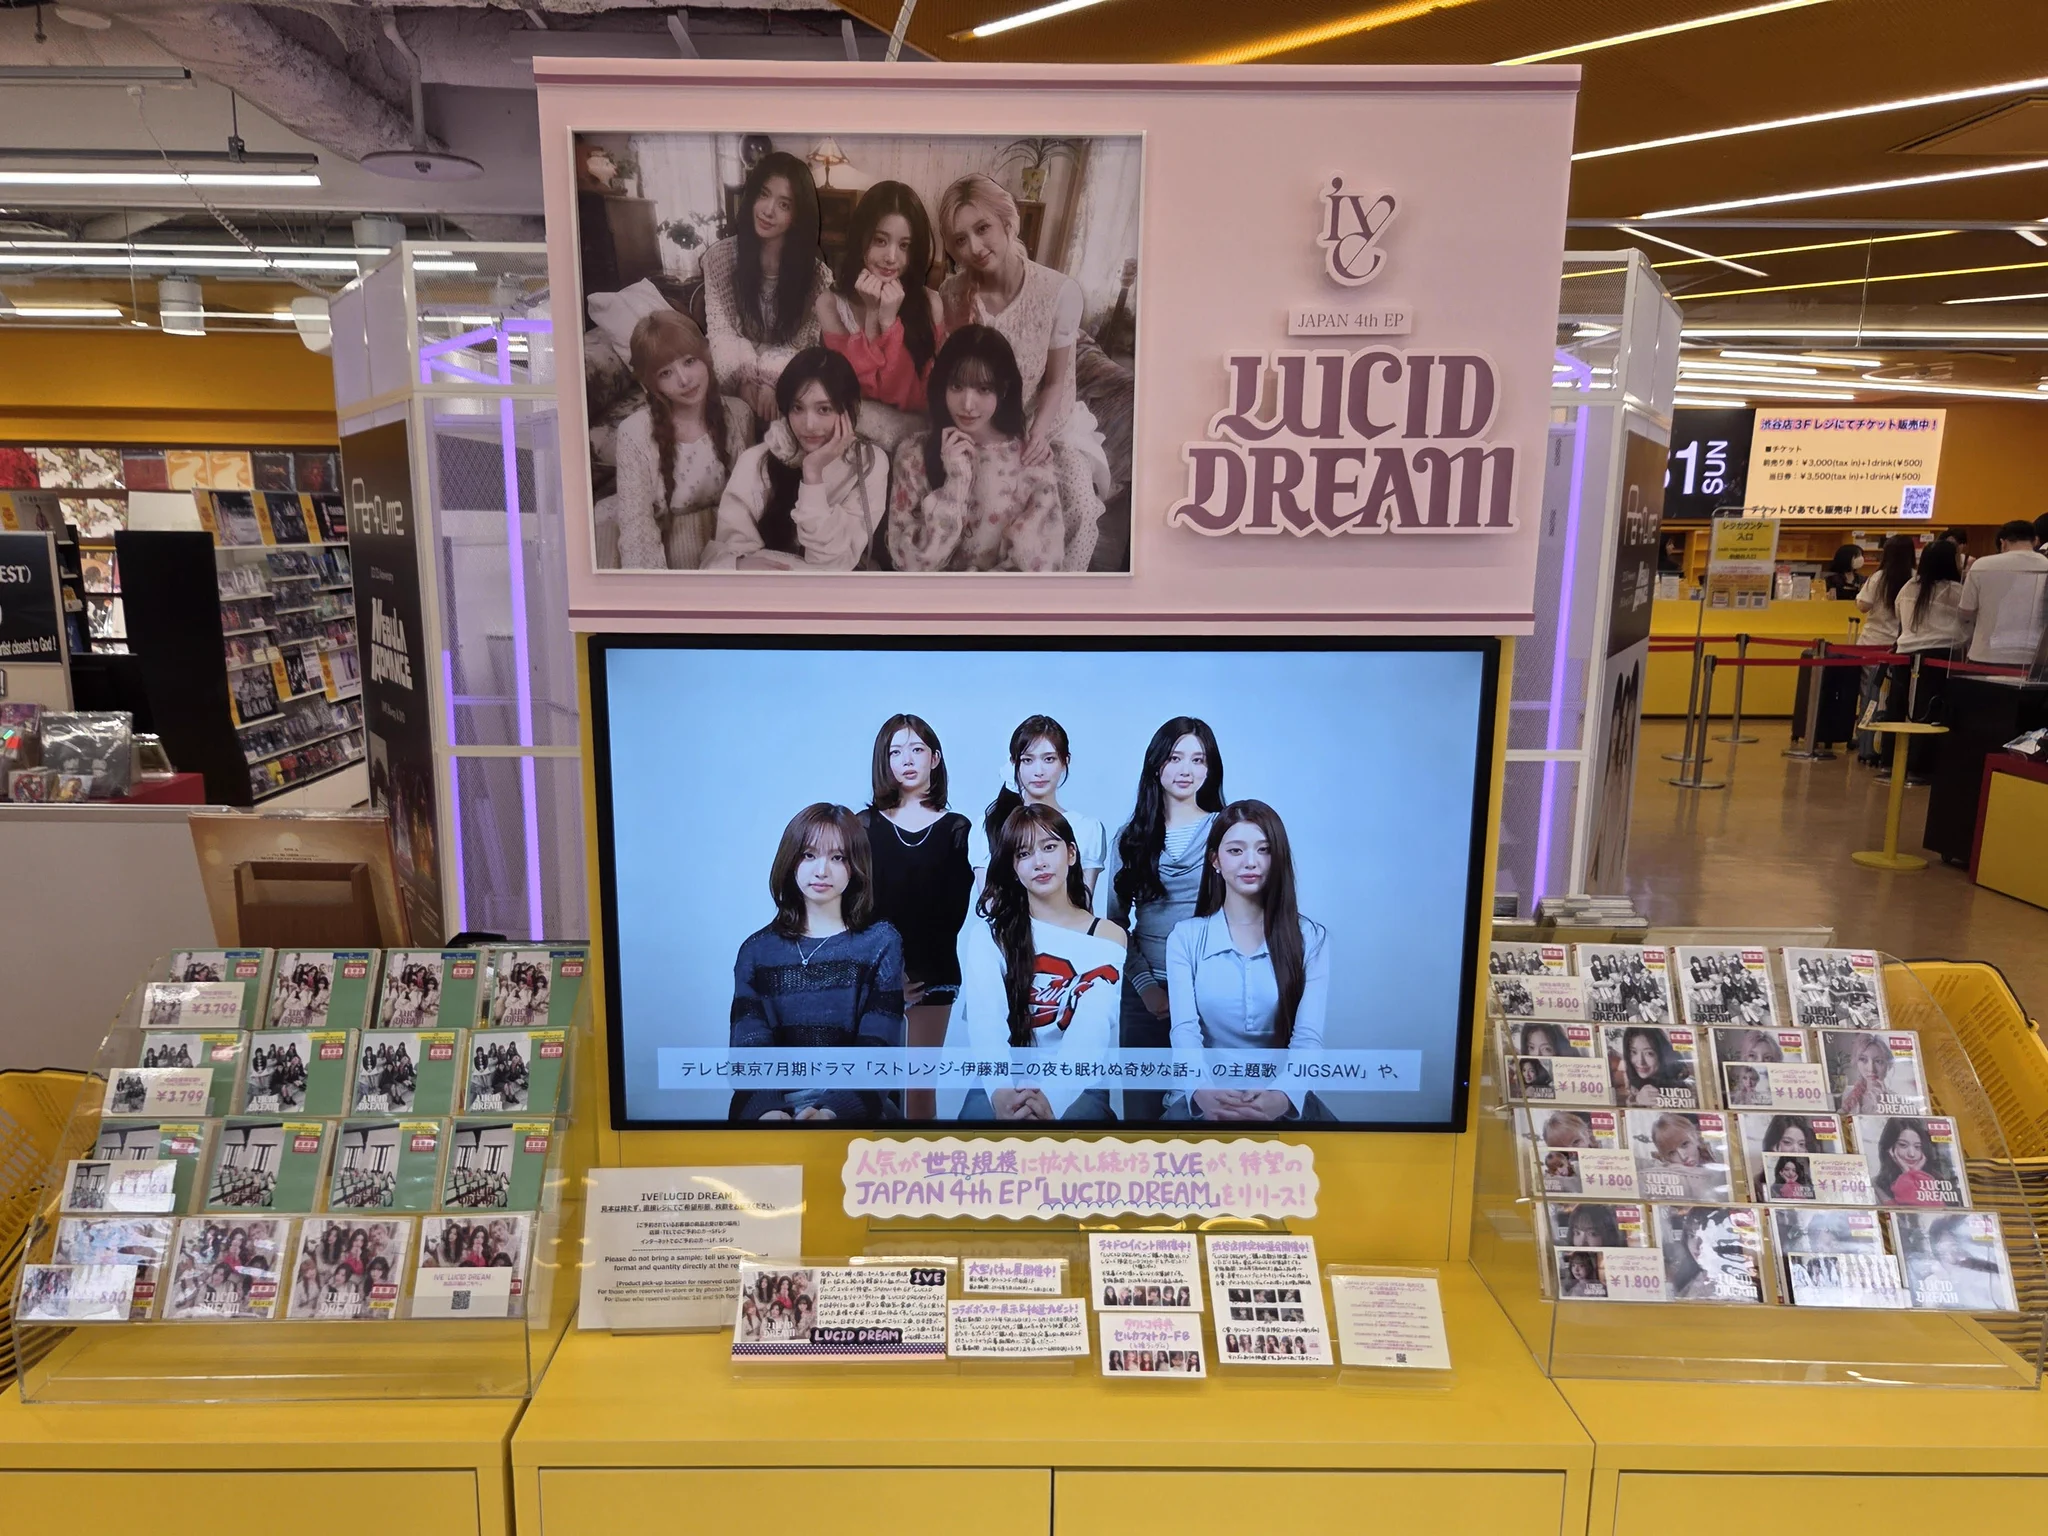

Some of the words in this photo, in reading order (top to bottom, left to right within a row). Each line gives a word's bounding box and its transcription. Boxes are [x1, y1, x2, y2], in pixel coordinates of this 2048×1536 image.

[1298, 314, 1349, 327] JAPAN
[1354, 313, 1378, 327] 4th
[1384, 314, 1404, 327] EP
[1215, 351, 1495, 441] LUCID
[1702, 441, 1728, 494] SUN
[1175, 447, 1515, 530] DREAM
[1723, 522, 1769, 530] レジカウンター
[1595, 1002, 1626, 1012] LUCID
[1697, 1004, 1728, 1013] LUCID
[1804, 1006, 1836, 1016] LUCID
[1592, 1012, 1629, 1021] DREAM
[1694, 1013, 1731, 1023] DREAM
[1800, 1016, 1839, 1026] DREAM
[1660, 1087, 1692, 1097] LUCID
[1656, 1097, 1696, 1108] DREAM
[1877, 1103, 1918, 1115] DREAM
[1644, 1174, 1680, 1185] LUCID
[1919, 1179, 1953, 1191] LUCID
[855, 1181, 944, 1205] JAPAN
[949, 1181, 991, 1204] 4th
[1645, 1184, 1685, 1196] DREAM
[1916, 1190, 1959, 1202] DREAM
[683, 1263, 707, 1271] directly
[914, 1271, 941, 1283] IVE
[1918, 1280, 1953, 1292] LUCID
[1915, 1291, 1959, 1303] DREAM
[320, 1302, 362, 1315] DREAM
[814, 1330, 858, 1340] LUCID
[861, 1330, 899, 1340] DREAM
